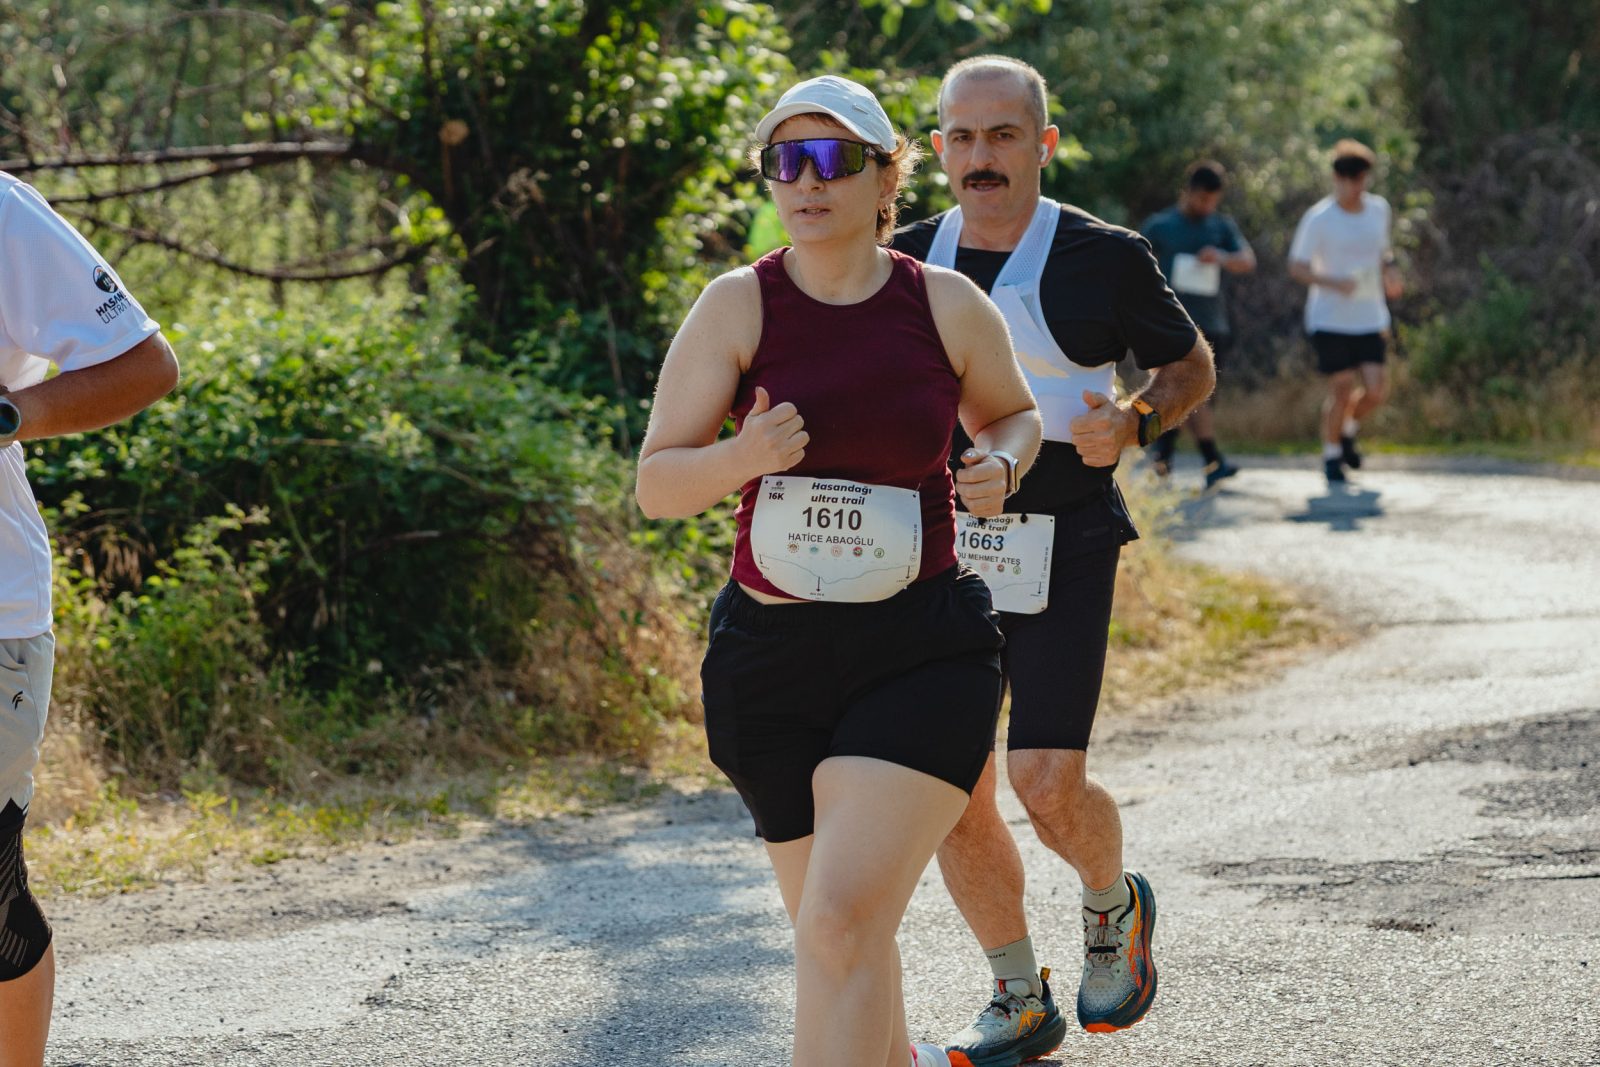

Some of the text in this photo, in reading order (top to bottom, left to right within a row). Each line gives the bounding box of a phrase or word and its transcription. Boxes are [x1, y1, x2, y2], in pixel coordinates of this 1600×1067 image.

[101, 302, 128, 324] ULTRA
[811, 481, 872, 495] Hasandağı
[768, 492, 785, 501] 16K
[811, 494, 866, 506] ultra trail
[802, 506, 863, 531] 1610
[989, 523, 1008, 532] trail
[788, 532, 874, 547] HATİCE ABAOĞLU
[959, 529, 1005, 552] 1663
[968, 553, 999, 563] MEHMET
